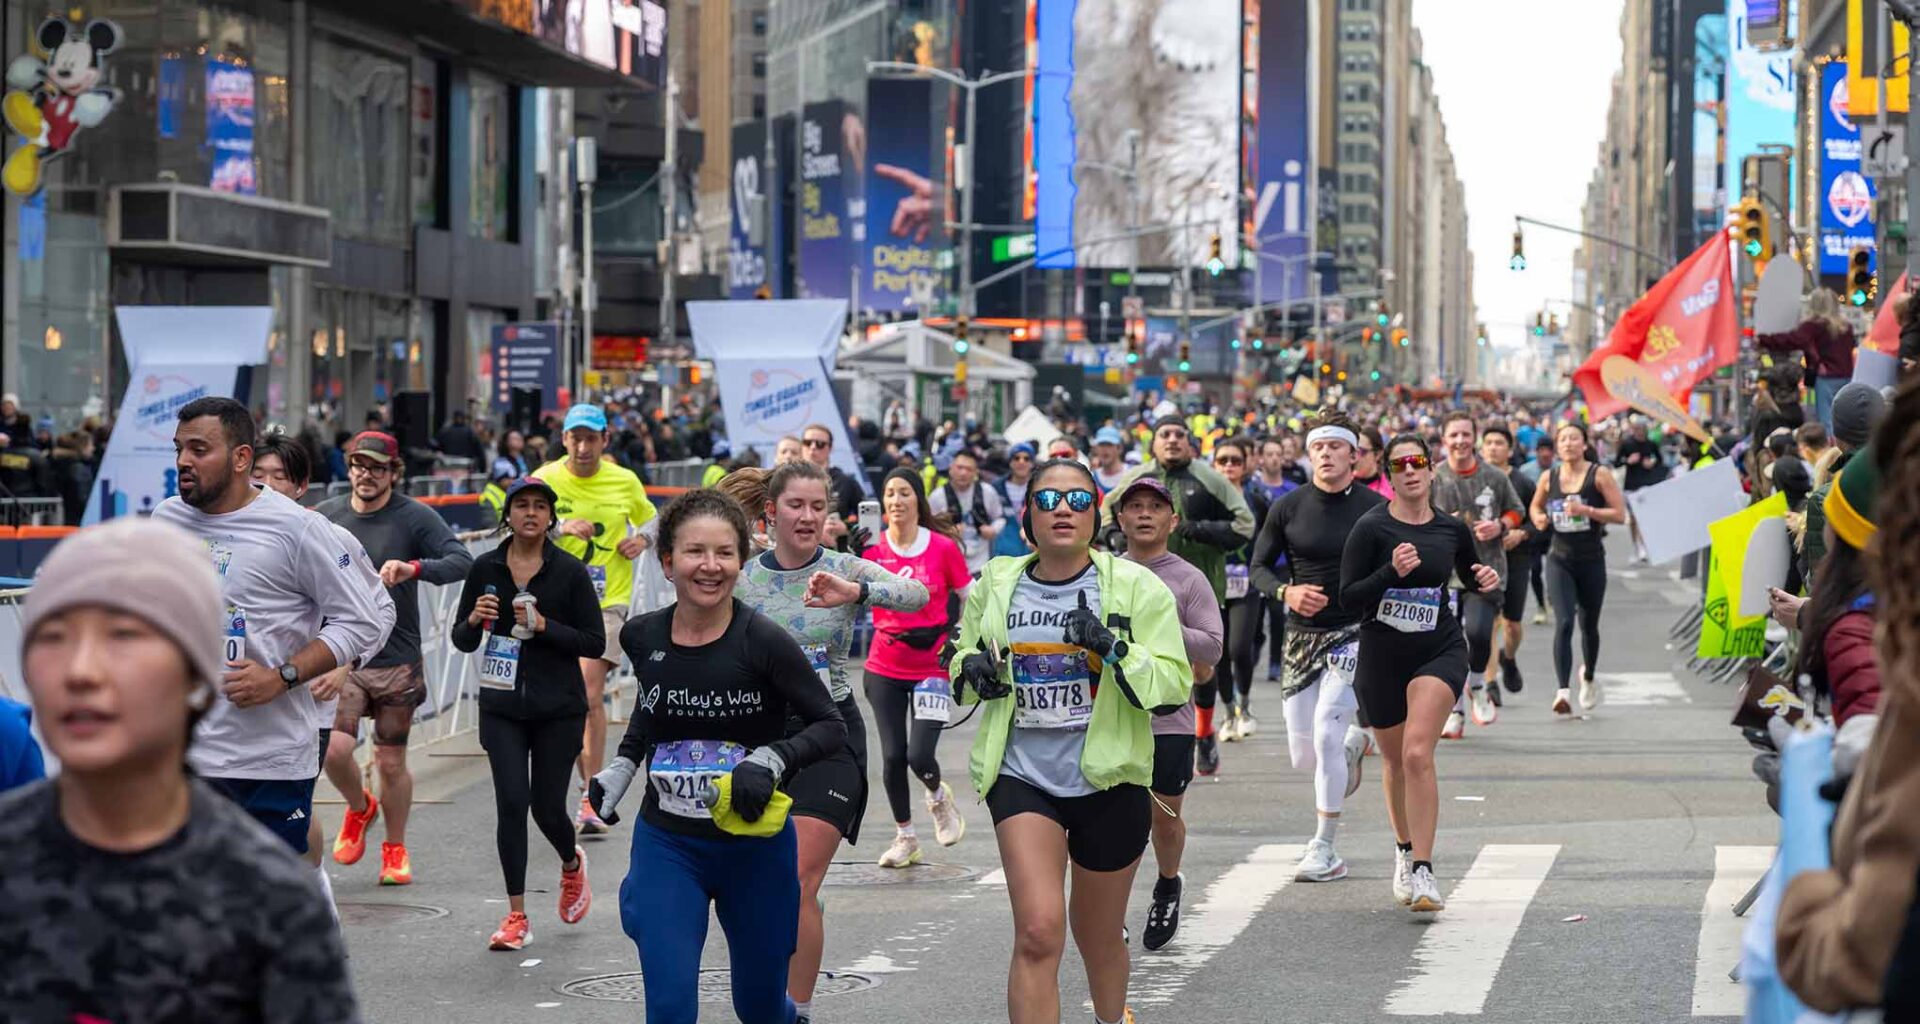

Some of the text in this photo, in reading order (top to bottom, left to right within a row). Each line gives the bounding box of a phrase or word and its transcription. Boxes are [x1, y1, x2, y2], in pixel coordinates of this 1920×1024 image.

[1383, 602, 1433, 624] B21080
[667, 689, 761, 709] Riley's Way
[1016, 682, 1083, 710] B18778
[667, 705, 763, 717] FOUNDATION
